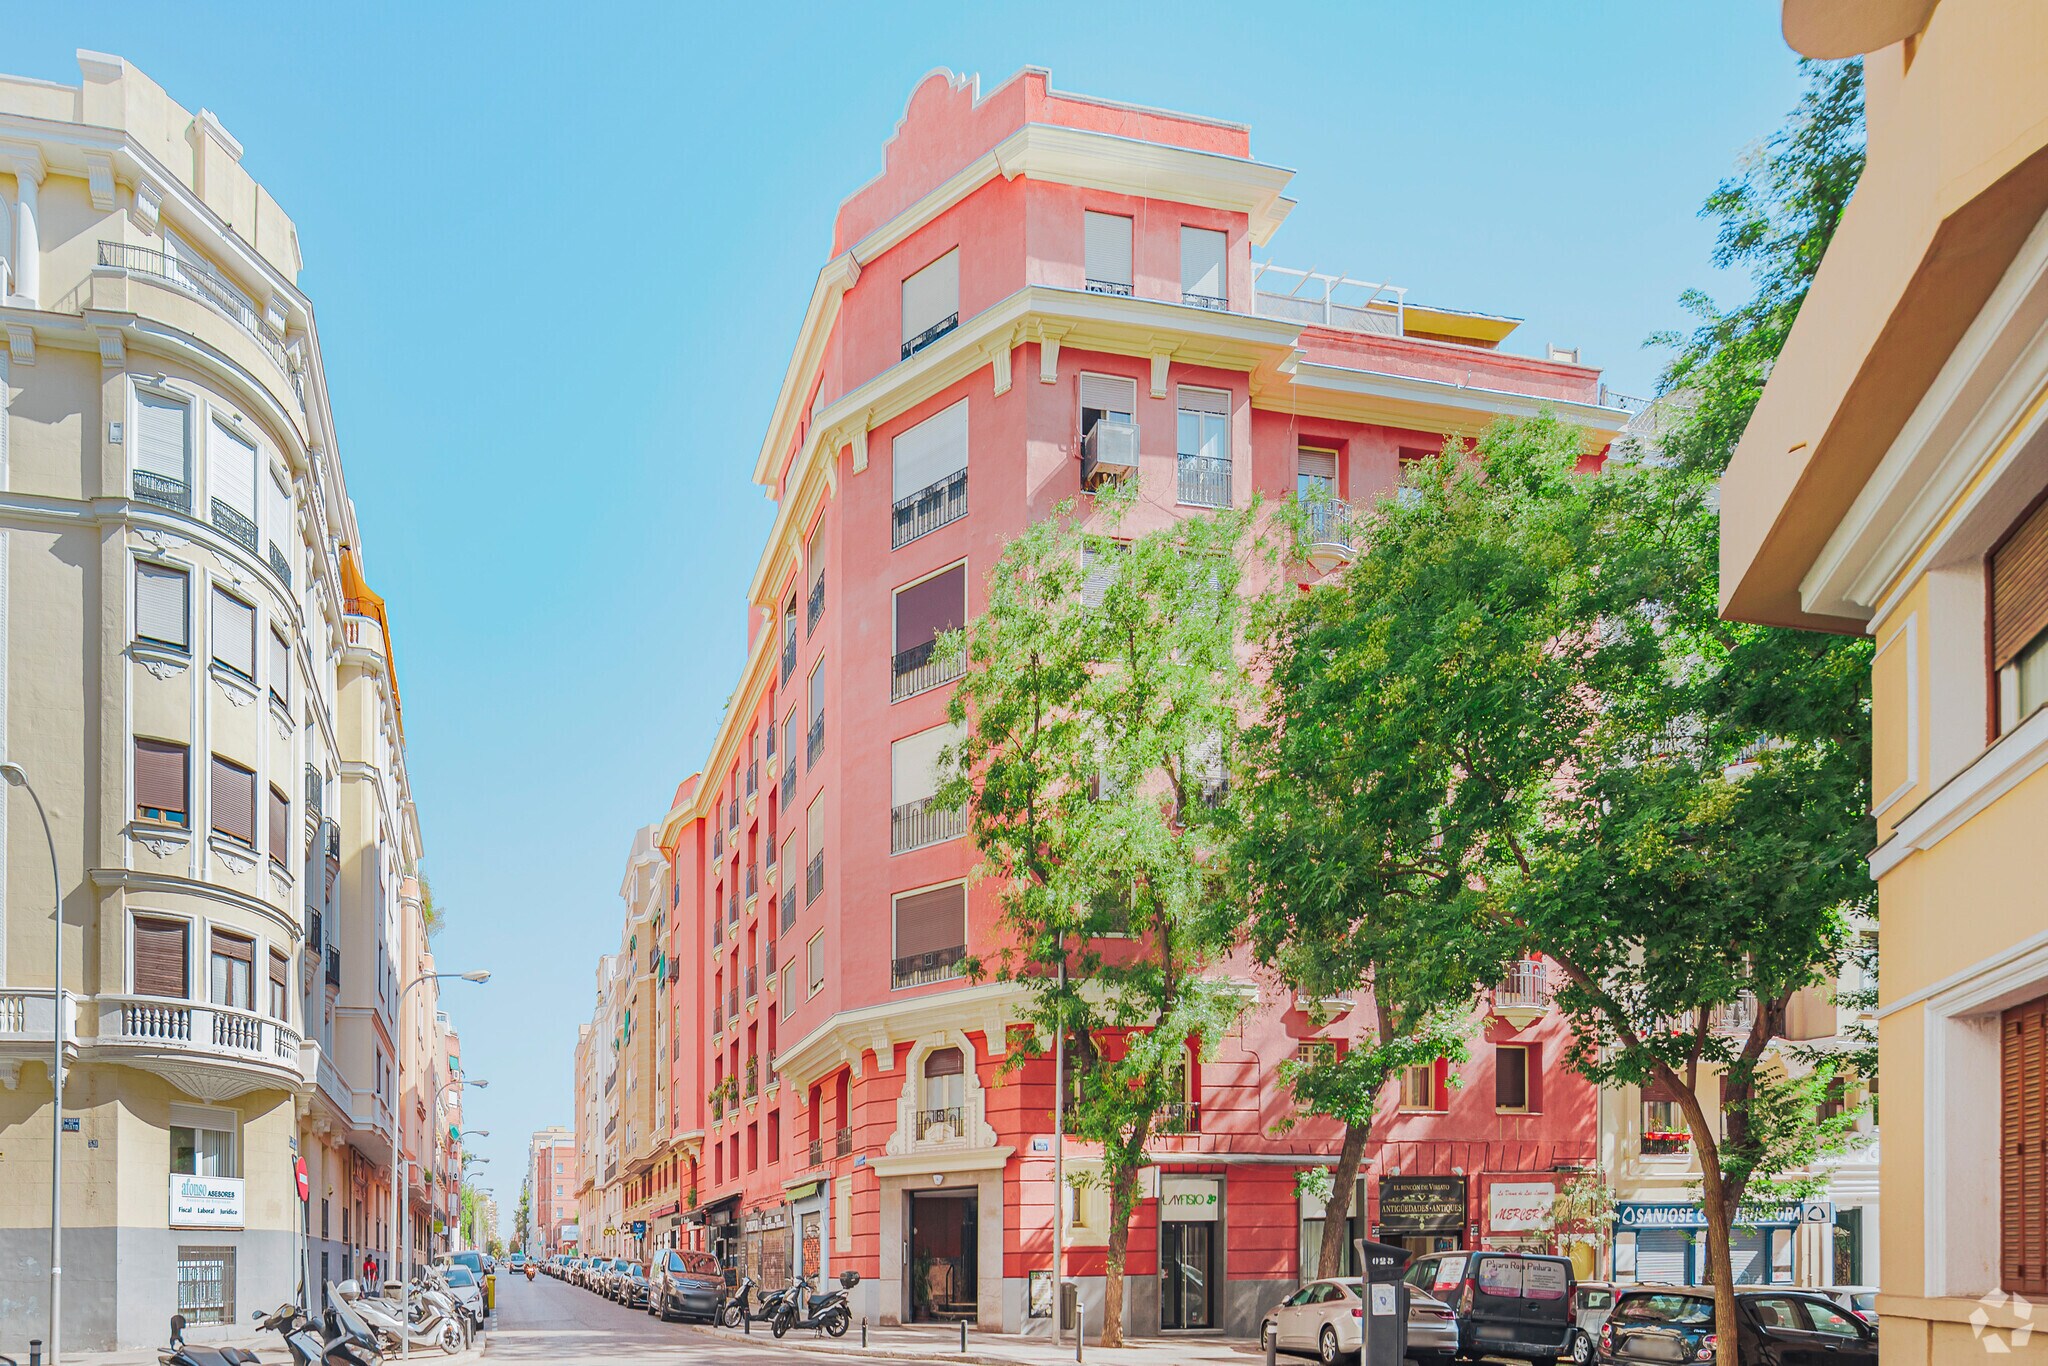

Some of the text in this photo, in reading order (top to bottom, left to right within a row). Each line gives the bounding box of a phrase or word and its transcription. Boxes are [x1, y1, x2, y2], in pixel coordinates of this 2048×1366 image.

[181, 1178, 235, 1198] afonso ASESORES
[1161, 1193, 1205, 1206] LAYFISIO
[1381, 1204, 1463, 1213] ANTIGÜEDADES ANTIQUES
[1636, 1207, 1694, 1224] SANJOSE
[1527, 1262, 1552, 1272] Pintura
